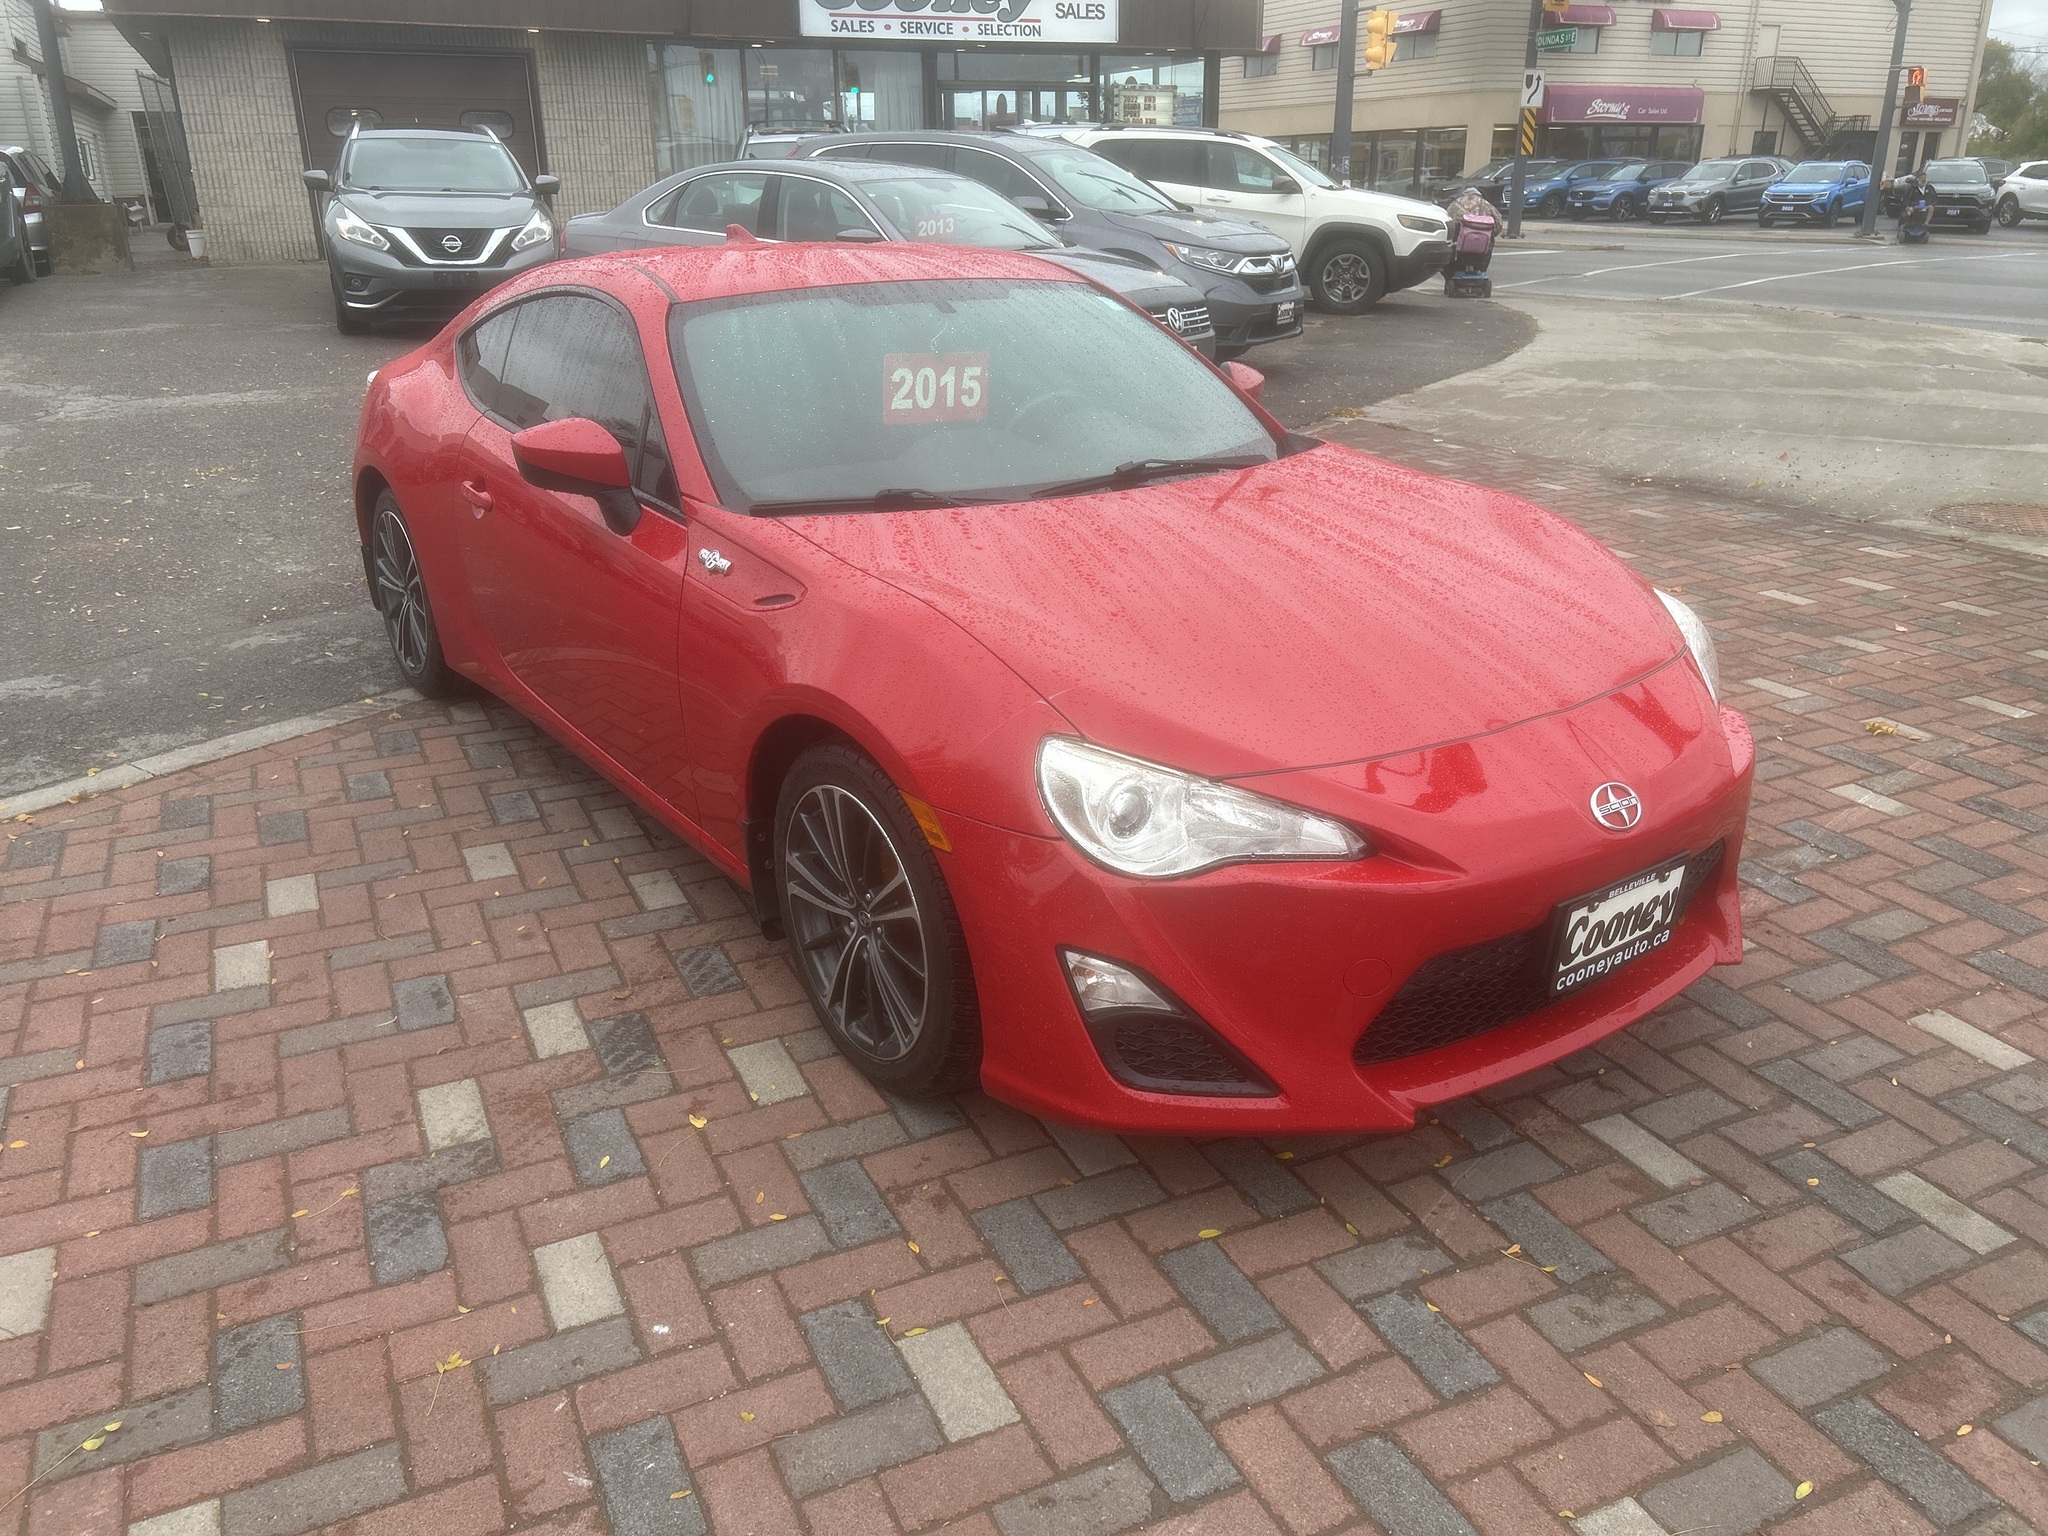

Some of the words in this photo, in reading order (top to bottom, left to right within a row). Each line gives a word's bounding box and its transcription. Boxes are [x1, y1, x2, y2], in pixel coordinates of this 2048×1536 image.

[1055, 3, 1105, 20] SALES
[831, 19, 875, 33] SALES
[899, 21, 954, 35] SERVICE
[977, 23, 1042, 37] SELECTION
[1537, 33, 1565, 46] DUNDAS
[1586, 98, 1631, 116] Stormy's
[918, 217, 954, 237] 2013
[891, 367, 982, 410] 2015
[1598, 796, 1639, 815] SCION
[1608, 873, 1657, 899] BELLEVILLE
[1559, 886, 1680, 967] Cooney
[1556, 929, 1671, 991] cooneyauto.ca
